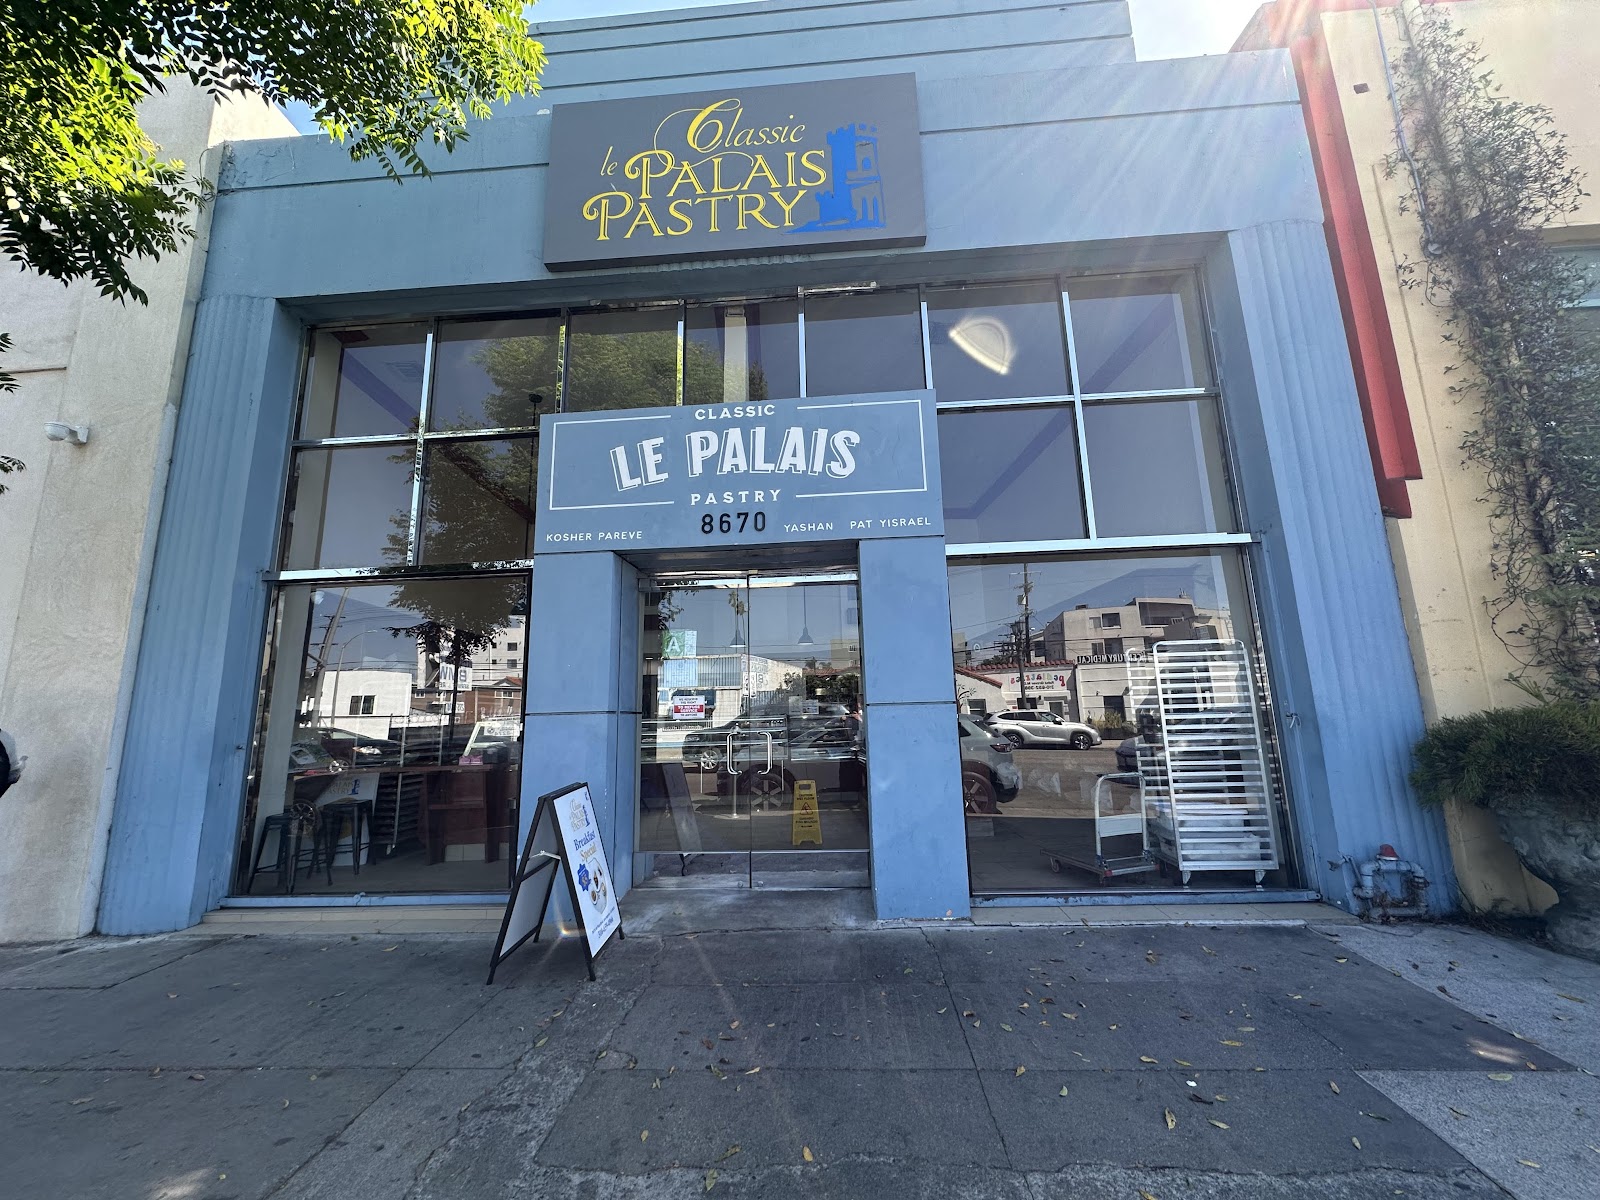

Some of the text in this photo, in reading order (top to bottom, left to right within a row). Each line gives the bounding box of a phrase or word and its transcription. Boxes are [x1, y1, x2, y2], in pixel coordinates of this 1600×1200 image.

[654, 98, 806, 153] Classic
[600, 145, 827, 199] le PALAIS
[582, 189, 807, 241] PASTRY
[694, 403, 776, 421] CLASSIC
[609, 426, 861, 492] LE PALAIS
[690, 488, 783, 506] PASTRY
[700, 511, 767, 534] 8670
[783, 516, 932, 533] YASHAN PAT YISRAEL
[546, 530, 643, 542] KOSHER PAREVE
[666, 636, 680, 652] A
